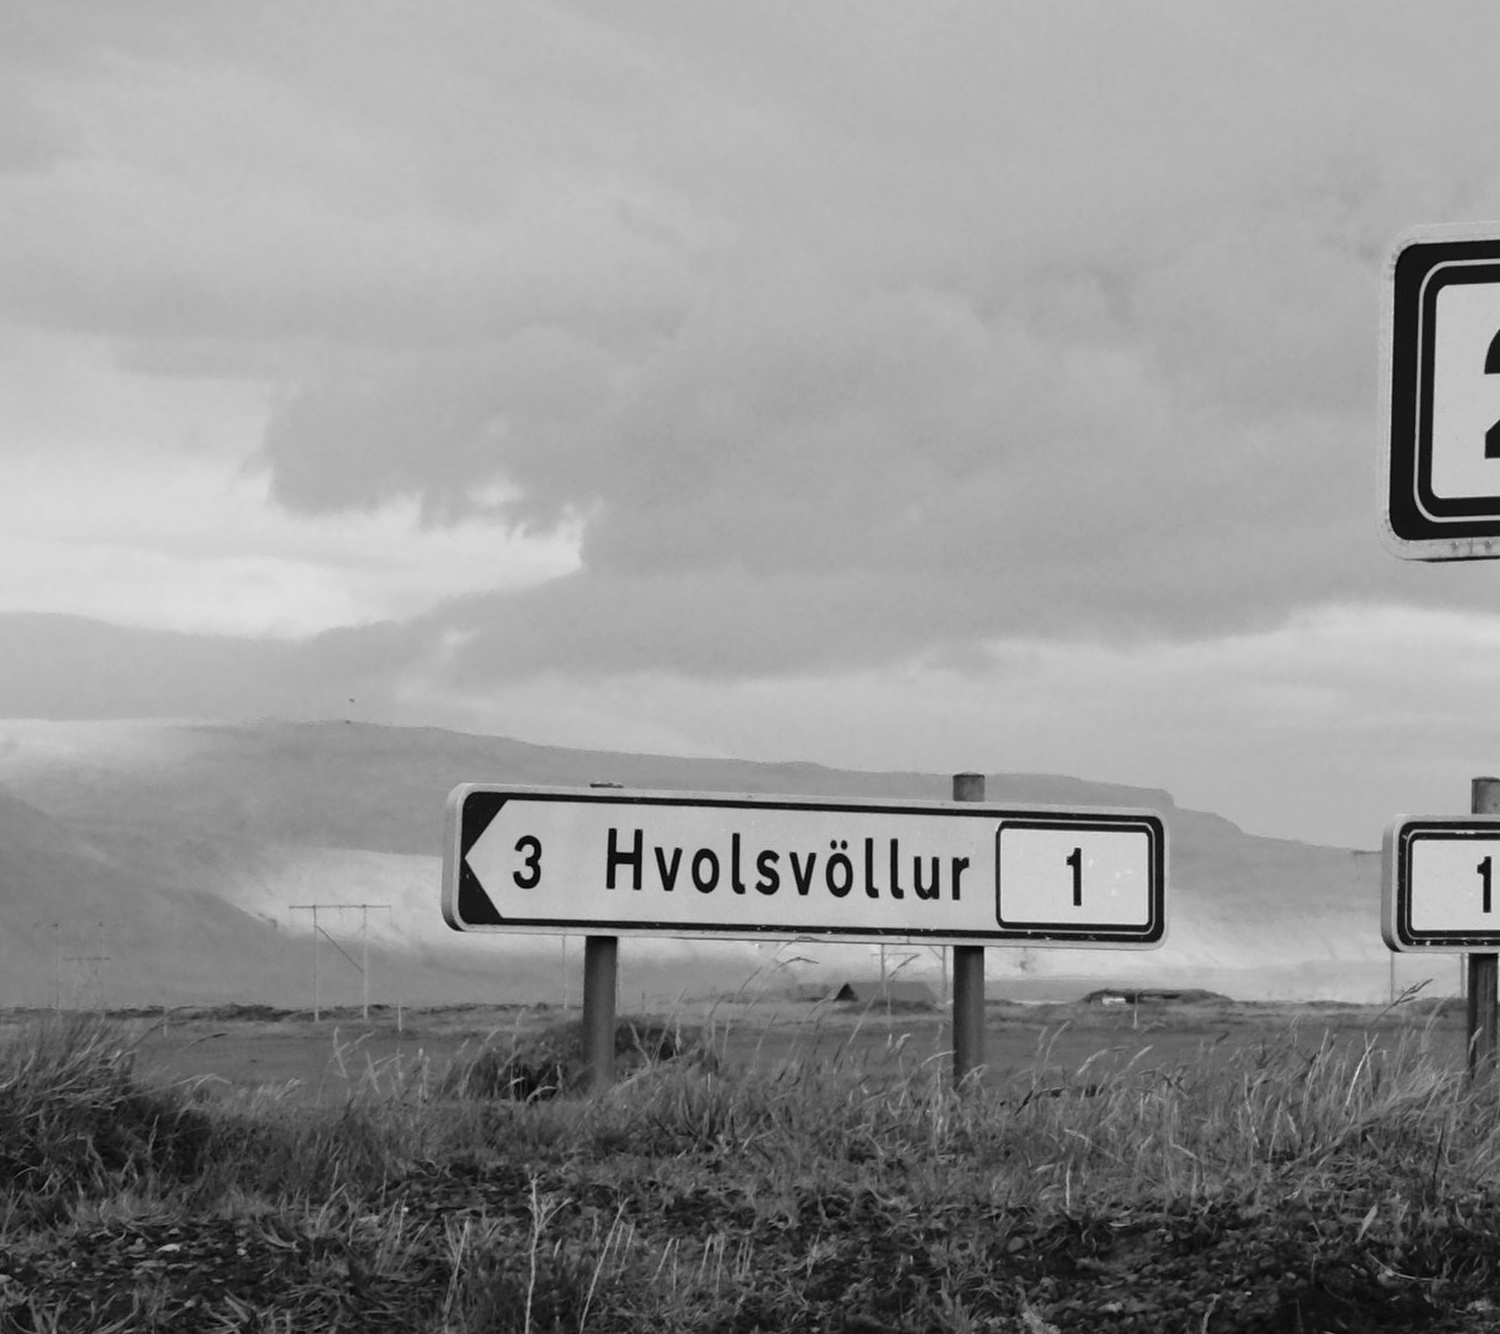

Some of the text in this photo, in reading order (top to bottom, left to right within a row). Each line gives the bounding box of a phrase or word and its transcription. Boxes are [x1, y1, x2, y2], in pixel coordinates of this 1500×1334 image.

[511, 827, 1083, 908] 3 Hvolsvöllur 1
[1476, 855, 1493, 914] 1
